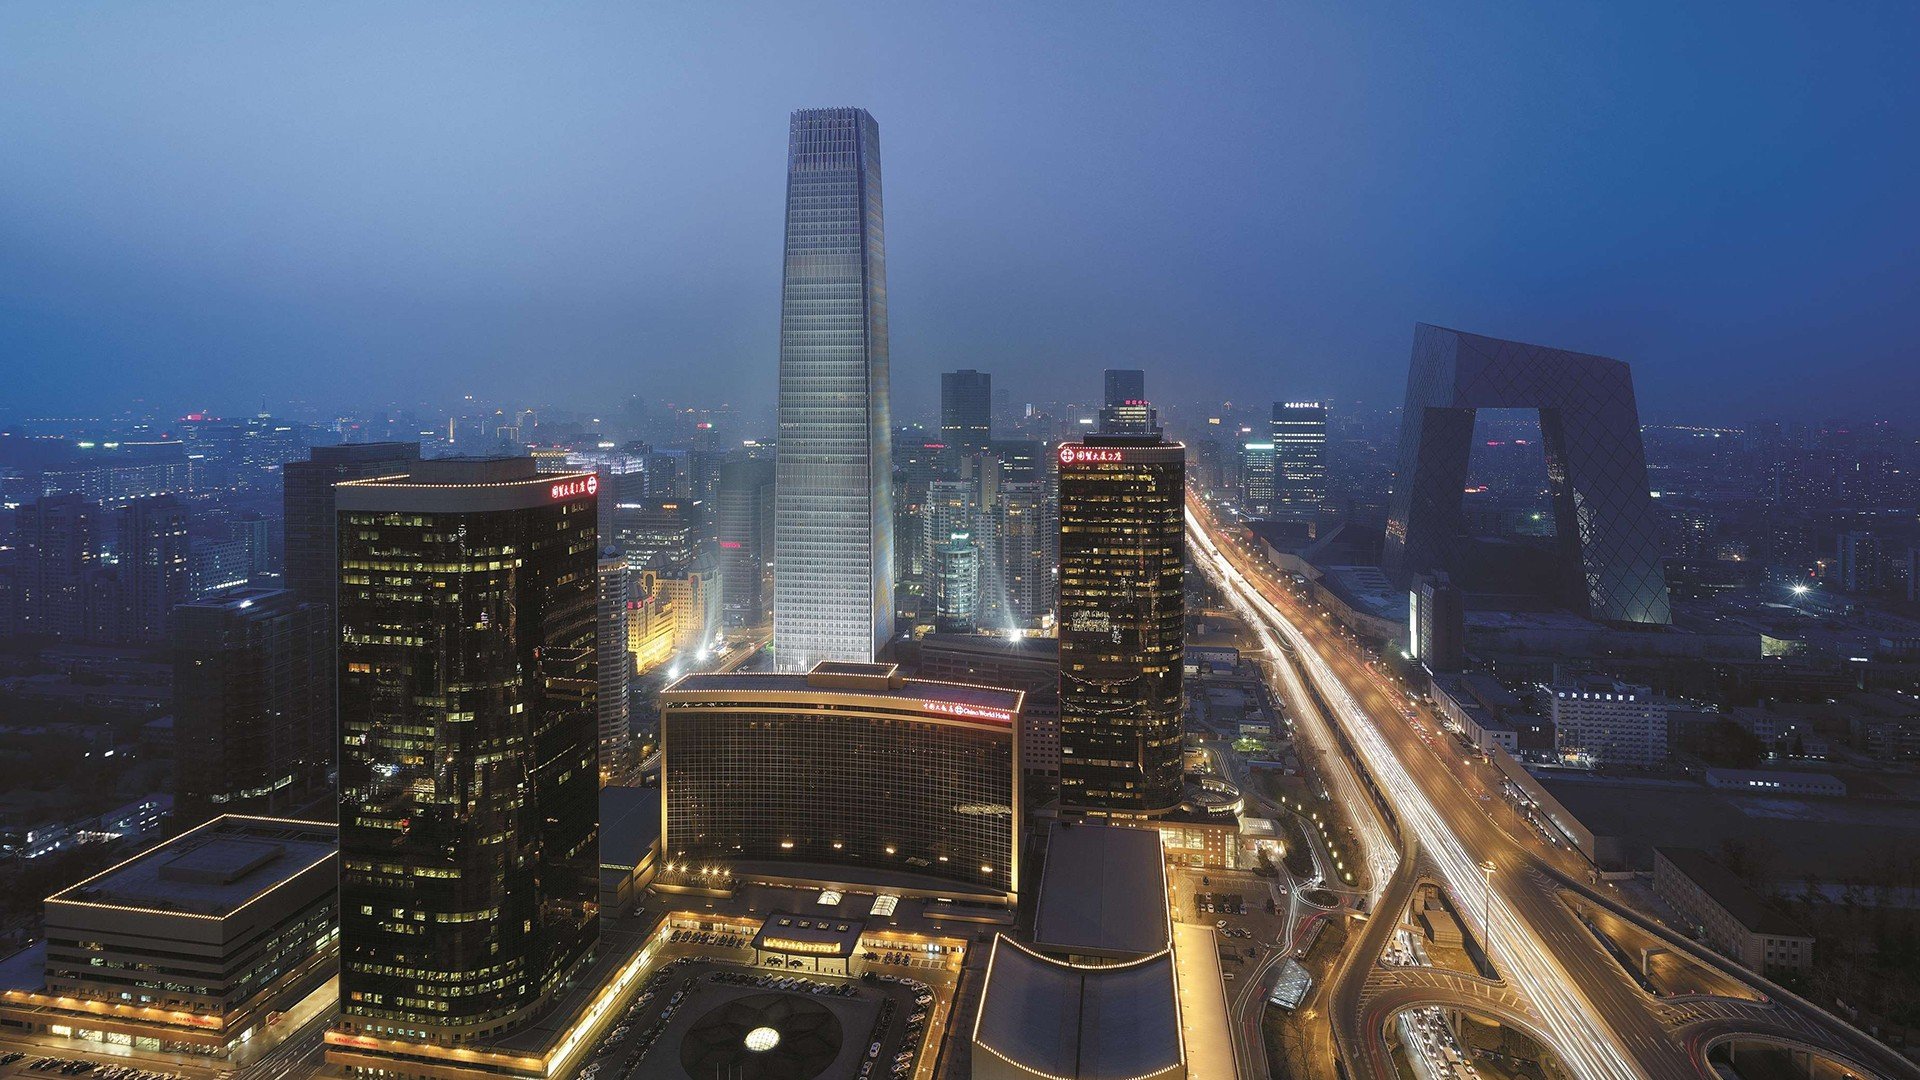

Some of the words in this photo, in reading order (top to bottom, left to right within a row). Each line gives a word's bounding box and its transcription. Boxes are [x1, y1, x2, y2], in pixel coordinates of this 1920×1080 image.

[964, 708, 979, 716] China
[979, 710, 995, 718] World
[996, 712, 1010, 720] Hotel
